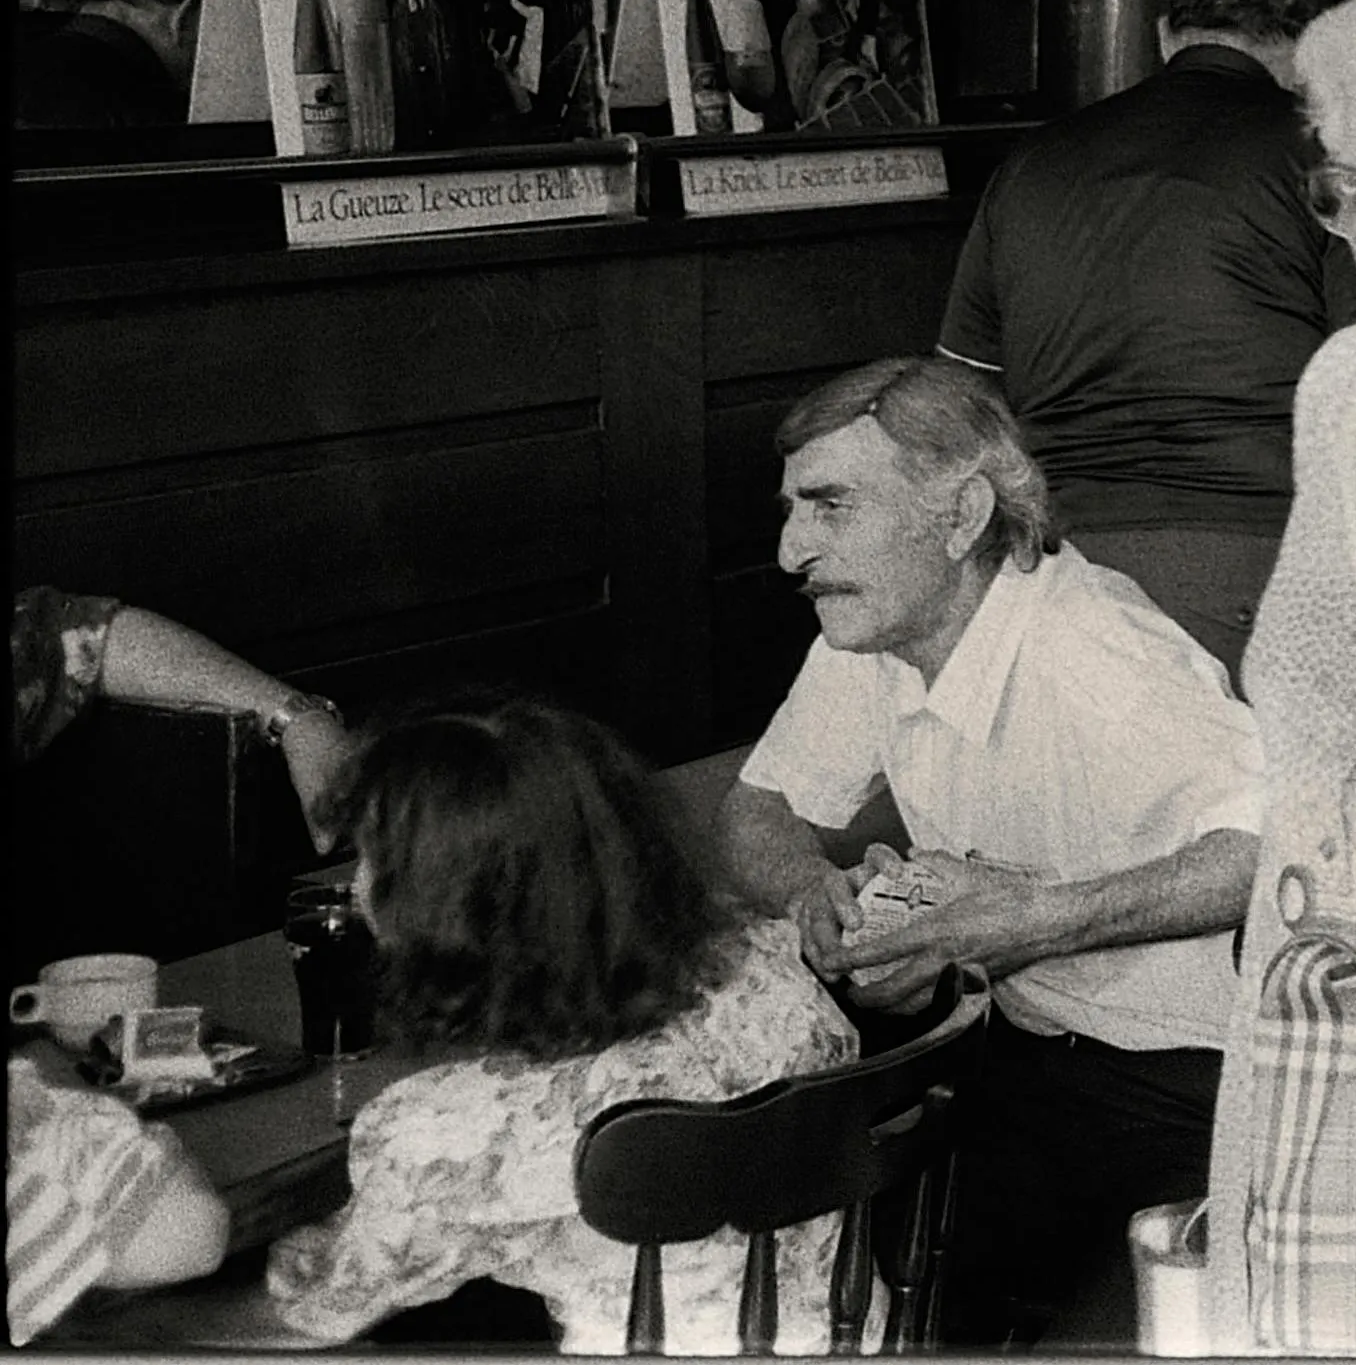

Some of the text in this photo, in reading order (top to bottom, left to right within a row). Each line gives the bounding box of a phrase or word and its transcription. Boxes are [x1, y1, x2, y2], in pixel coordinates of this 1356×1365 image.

[775, 161, 799, 190] Le
[851, 156, 869, 185] de
[294, 193, 325, 224] La
[418, 182, 444, 213] Le
[447, 184, 503, 209] secret
[507, 172, 532, 204] de
